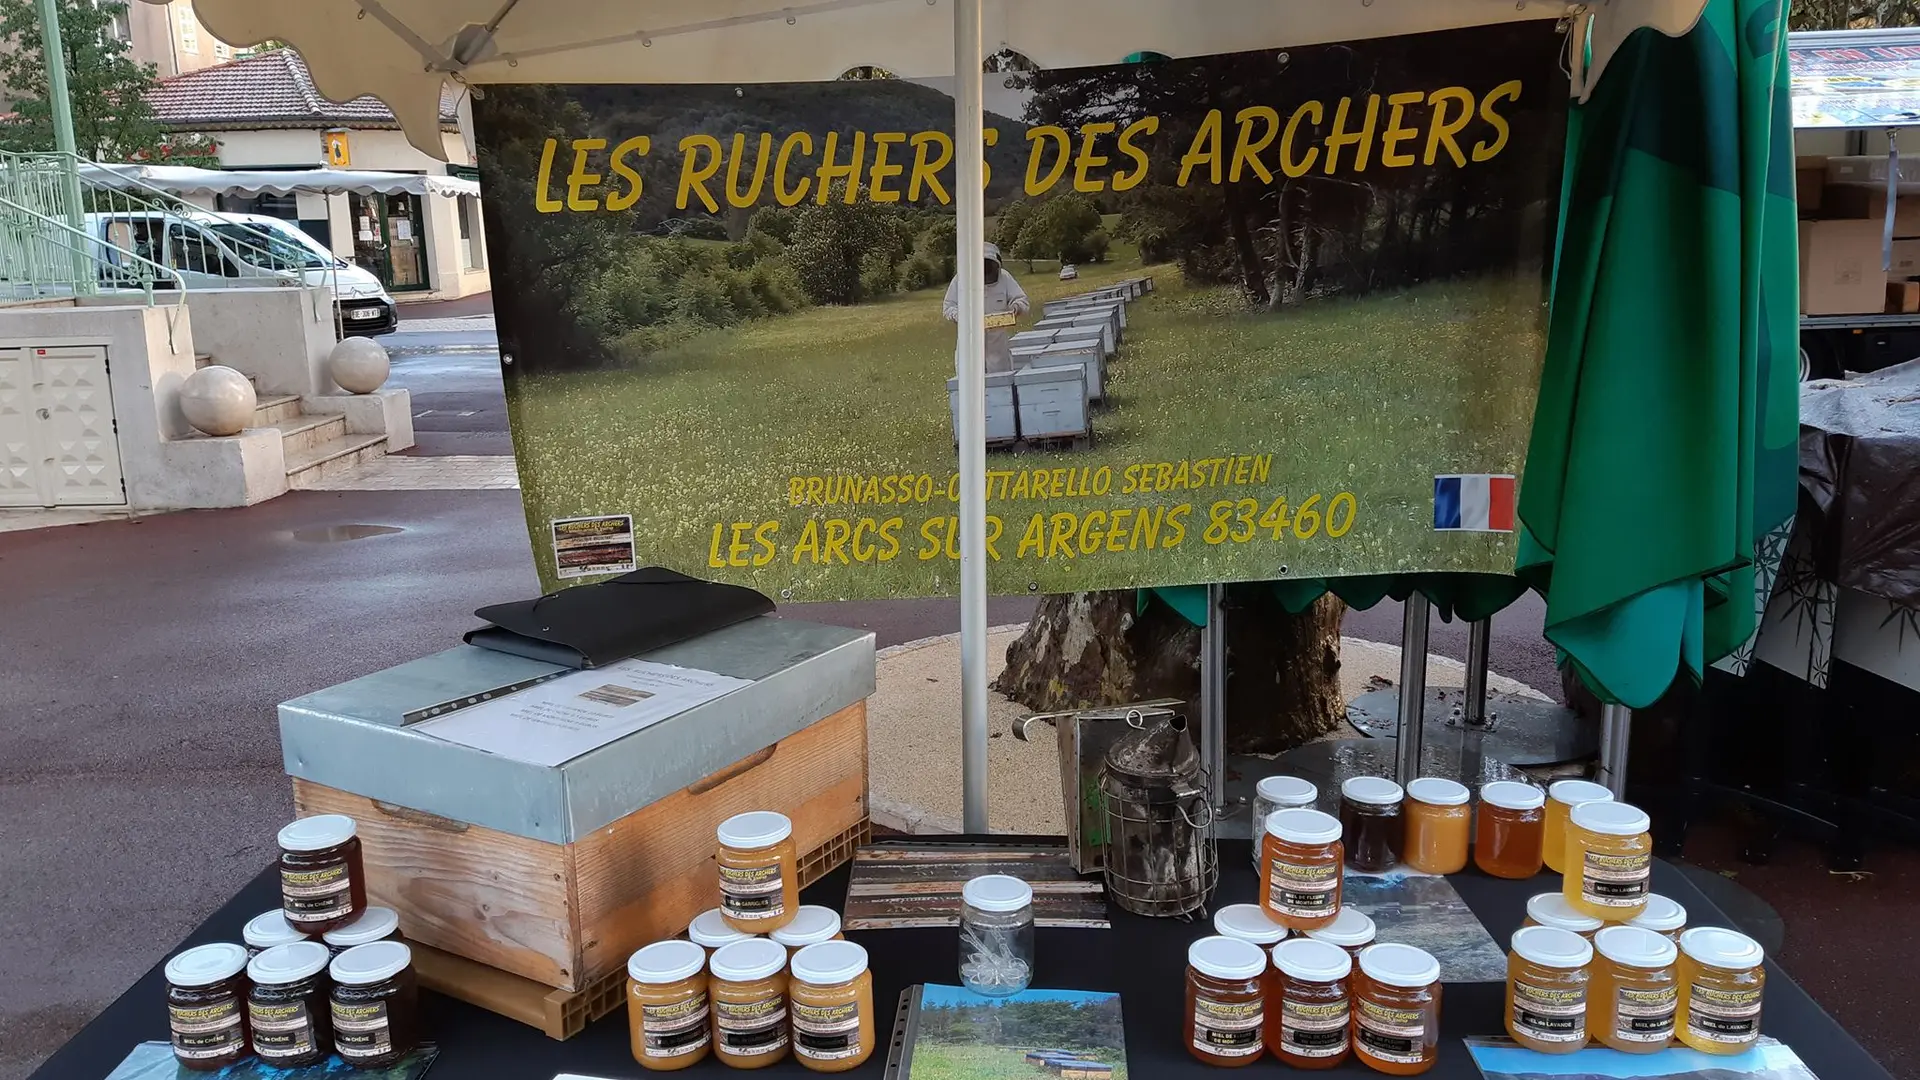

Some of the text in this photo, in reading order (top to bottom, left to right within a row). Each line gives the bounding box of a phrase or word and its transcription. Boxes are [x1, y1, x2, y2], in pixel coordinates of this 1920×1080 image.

[534, 135, 650, 214] LES
[1022, 115, 1160, 197] DES
[1176, 78, 1523, 188] ARCHERS
[1122, 452, 1273, 495] SEBASTIEN
[708, 519, 780, 569] LES
[792, 515, 904, 565] ARCS
[1016, 502, 1192, 560] ARGENS
[1202, 491, 1357, 545] 83460
